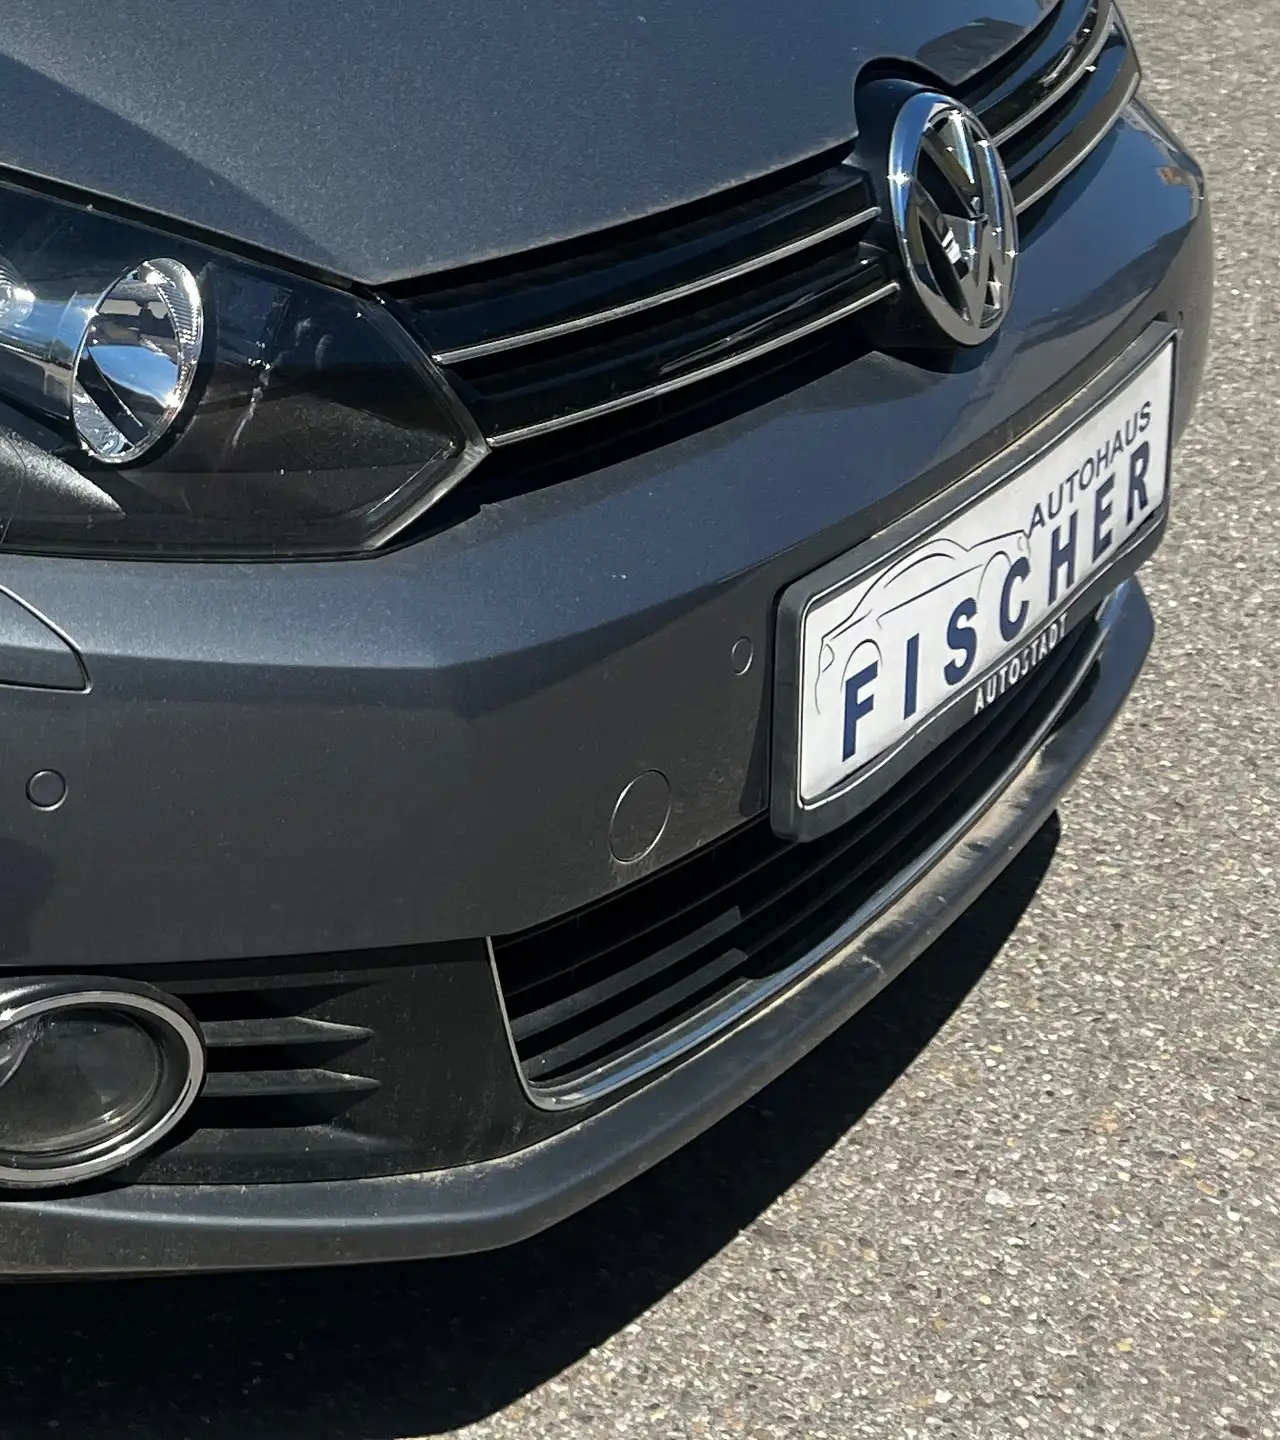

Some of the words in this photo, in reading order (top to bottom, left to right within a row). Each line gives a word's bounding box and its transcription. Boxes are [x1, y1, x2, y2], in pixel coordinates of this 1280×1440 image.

[1028, 400, 1152, 538] AUTOHAUS
[842, 440, 1151, 763] FISCHER
[973, 613, 1069, 714] AUTOSTADT
